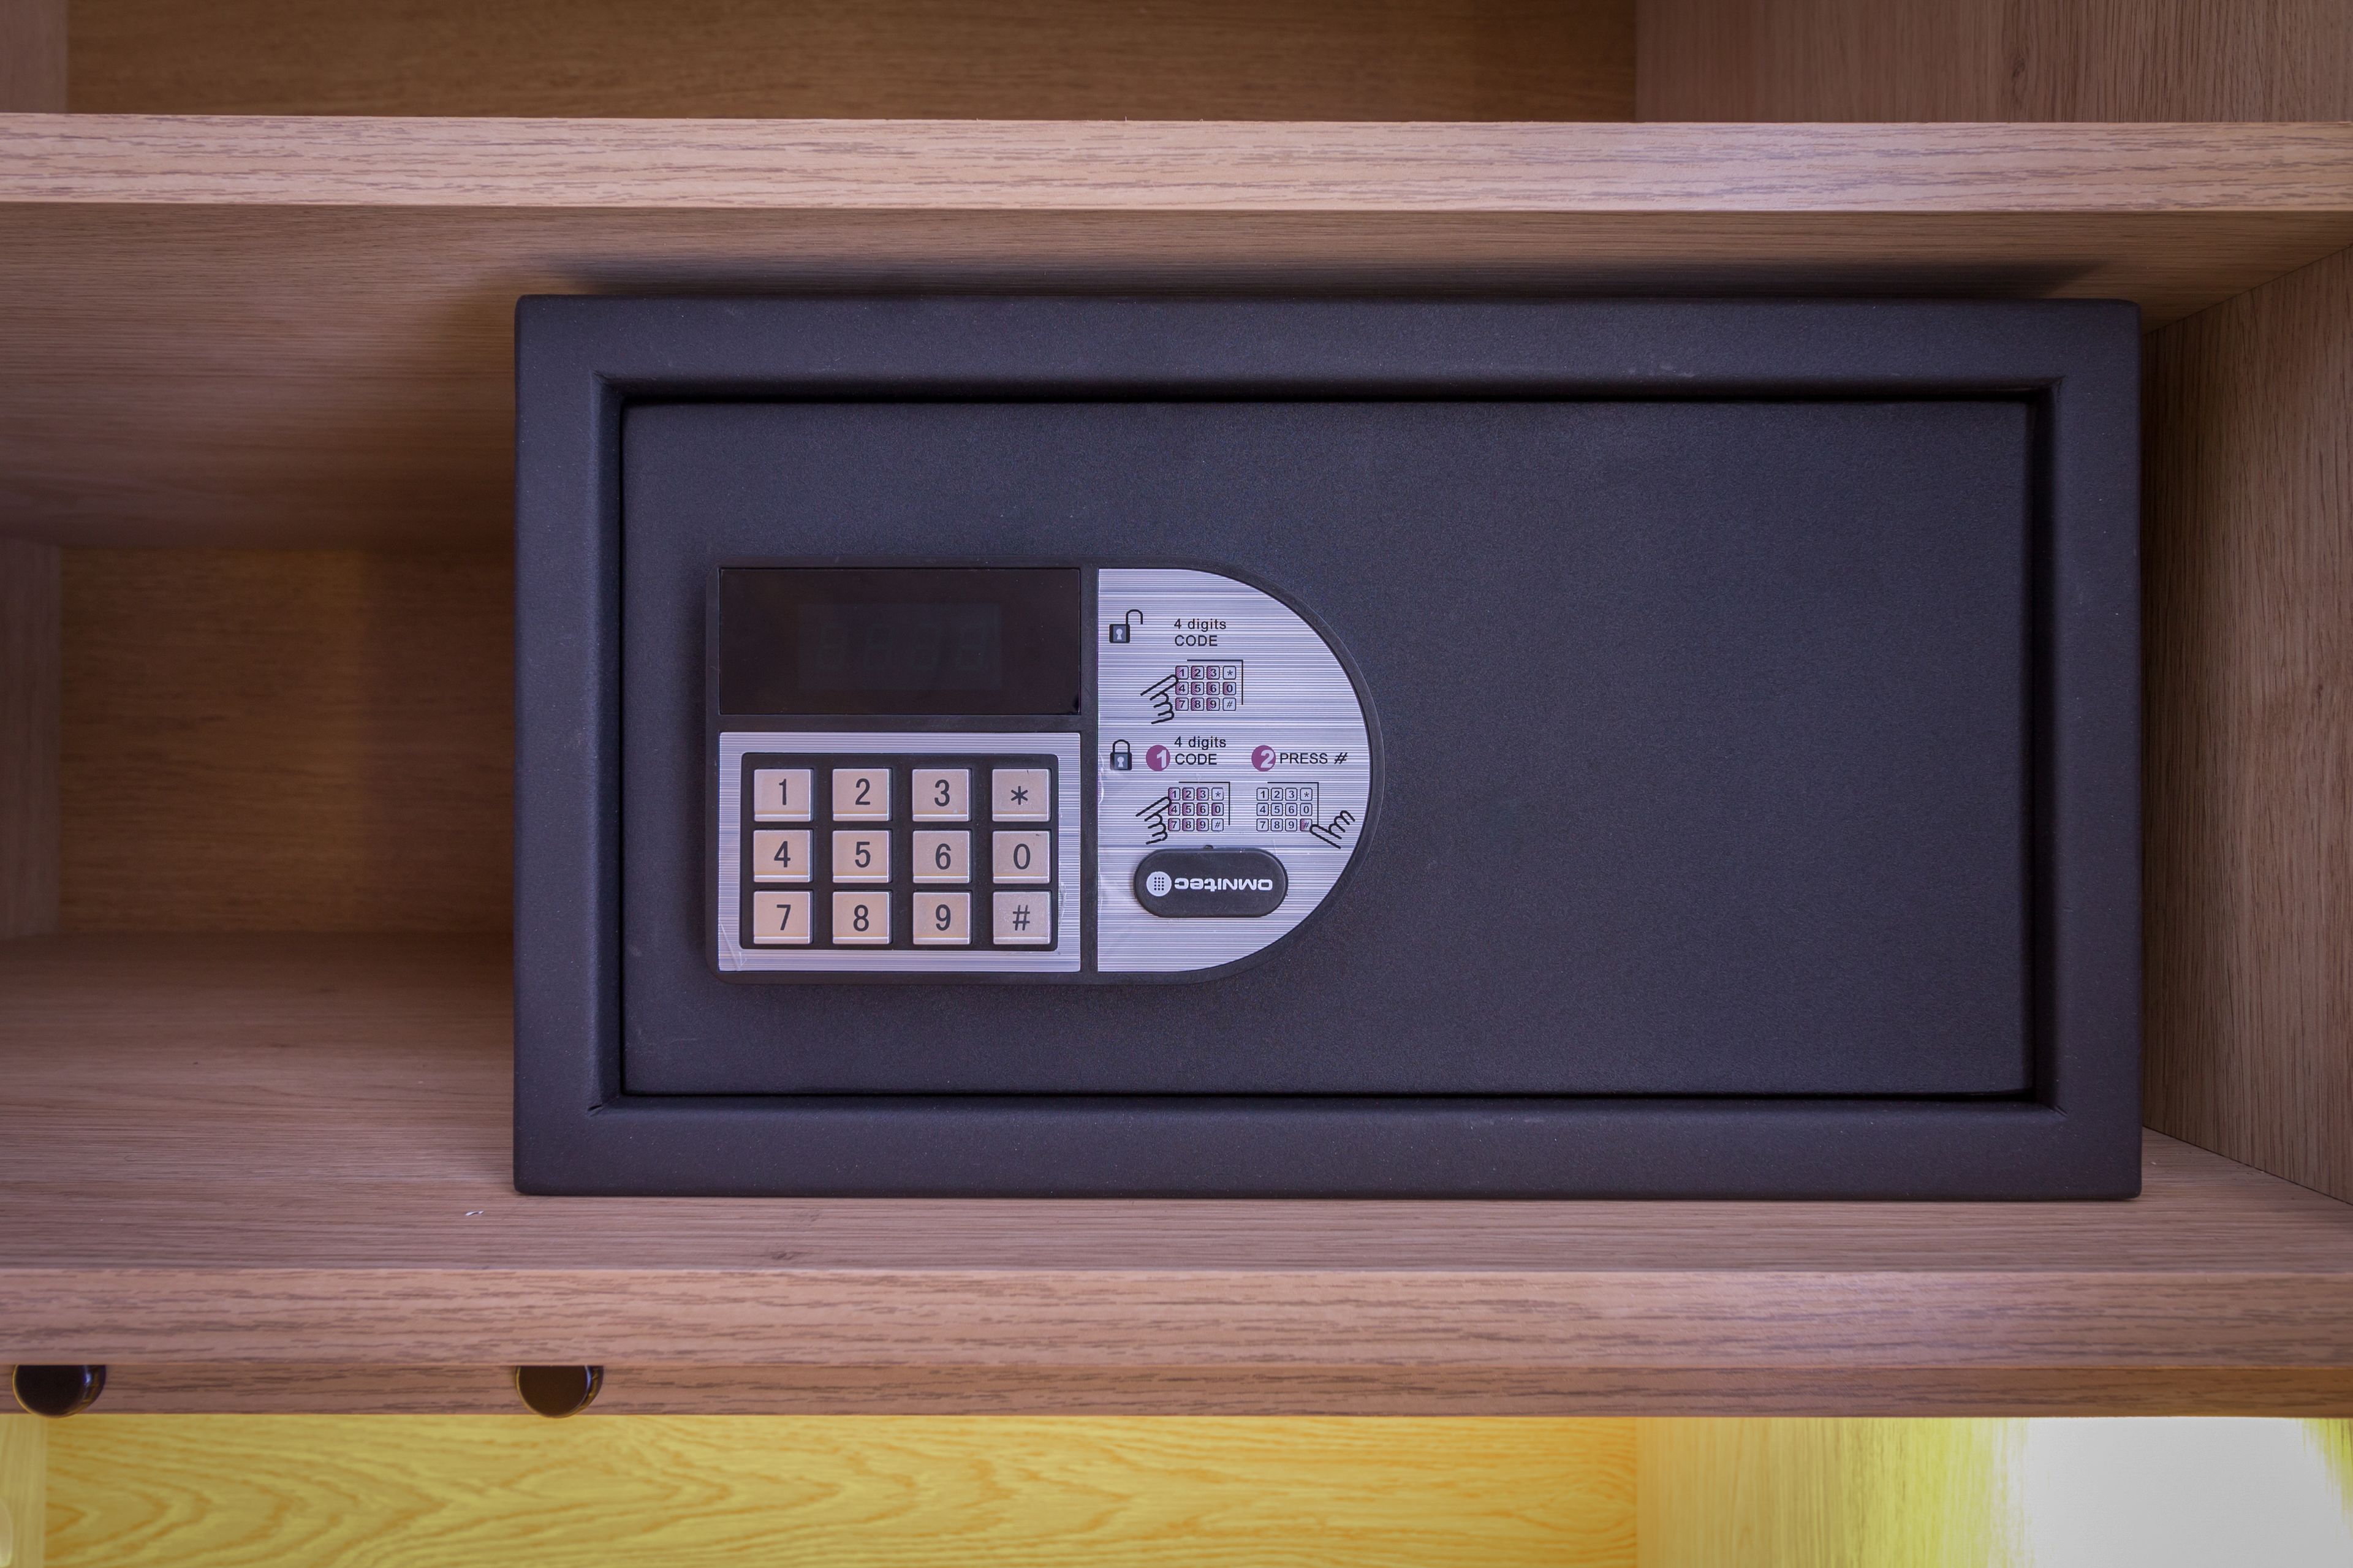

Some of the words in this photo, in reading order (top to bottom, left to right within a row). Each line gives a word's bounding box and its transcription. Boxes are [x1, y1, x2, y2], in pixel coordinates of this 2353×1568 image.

[1173, 619, 1182, 629] 4
[1187, 618, 1227, 632] digits
[1175, 635, 1218, 646] CODE
[1180, 700, 1186, 708] 7
[1195, 700, 1201, 708] 8
[1210, 700, 1216, 708] 9
[1174, 736, 1182, 748] 4
[1189, 736, 1226, 750] digits
[1157, 749, 1167, 768] 1
[1175, 754, 1217, 765] CODE
[1260, 749, 1275, 768] 2
[1280, 752, 1327, 763] PRESS
[1334, 752, 1348, 764] #
[778, 778, 787, 806] 1
[855, 778, 871, 806] 2
[934, 779, 950, 807] 3
[773, 841, 791, 868] 4
[855, 841, 871, 868] 5
[935, 843, 952, 870] 6
[1013, 843, 1031, 870] 0
[776, 904, 791, 931] 7
[853, 904, 870, 932] 8
[935, 904, 951, 931] 9
[1012, 904, 1031, 931] #
